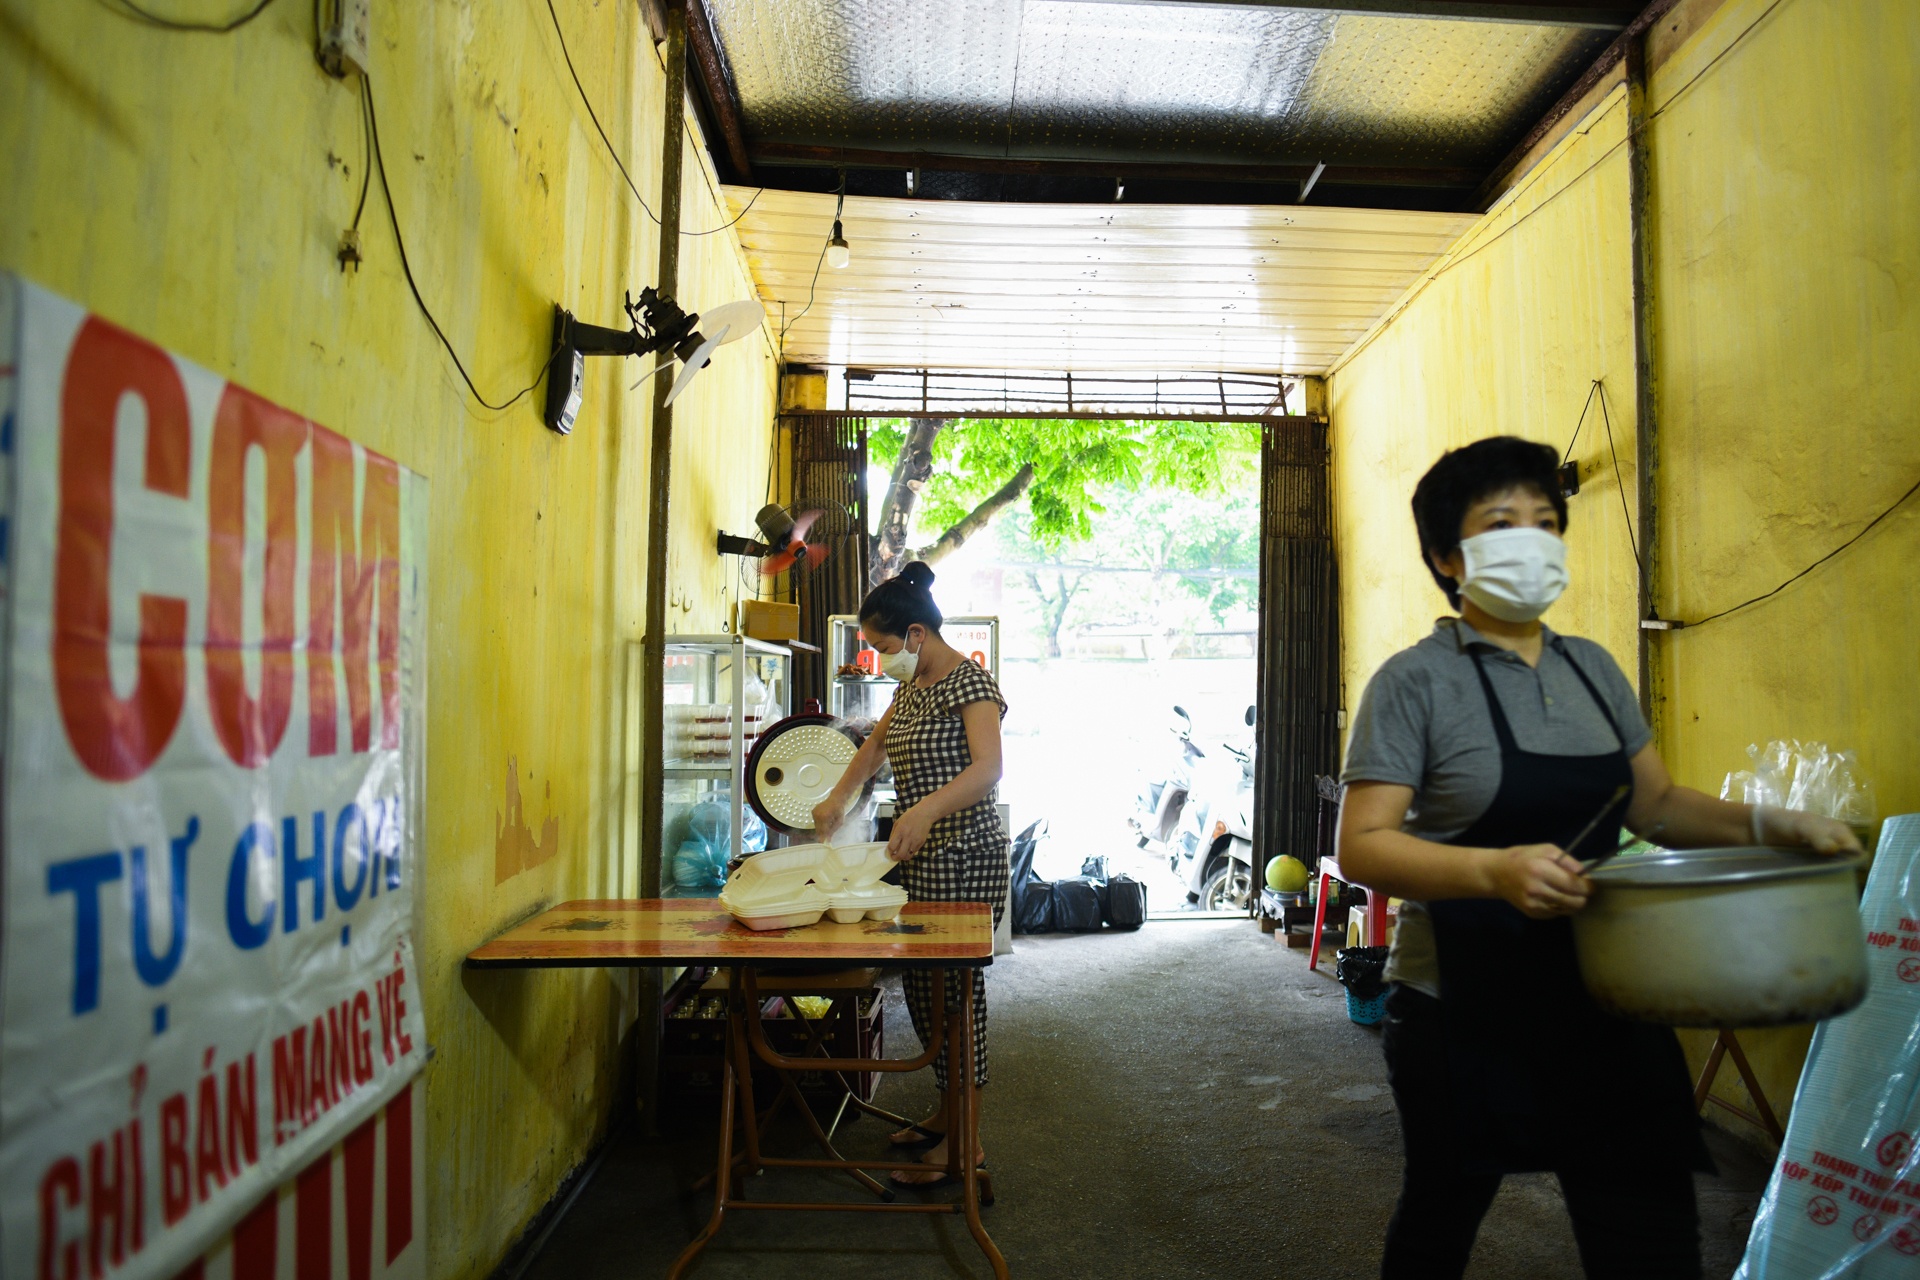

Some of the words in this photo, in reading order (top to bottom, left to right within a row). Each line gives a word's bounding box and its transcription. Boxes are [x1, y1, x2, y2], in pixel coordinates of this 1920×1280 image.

[46, 813, 201, 1037] TỰ
[225, 796, 400, 948] CHỌN
[1866, 930, 1897, 950] HỘP
[1899, 936, 1920, 953] XỐ
[38, 1062, 148, 1280] CHỈ
[158, 1045, 260, 1229] BÁN
[271, 989, 374, 1147] MANG
[1812, 1151, 1860, 1180] THANH
[1811, 1172, 1846, 1194] XỐP
